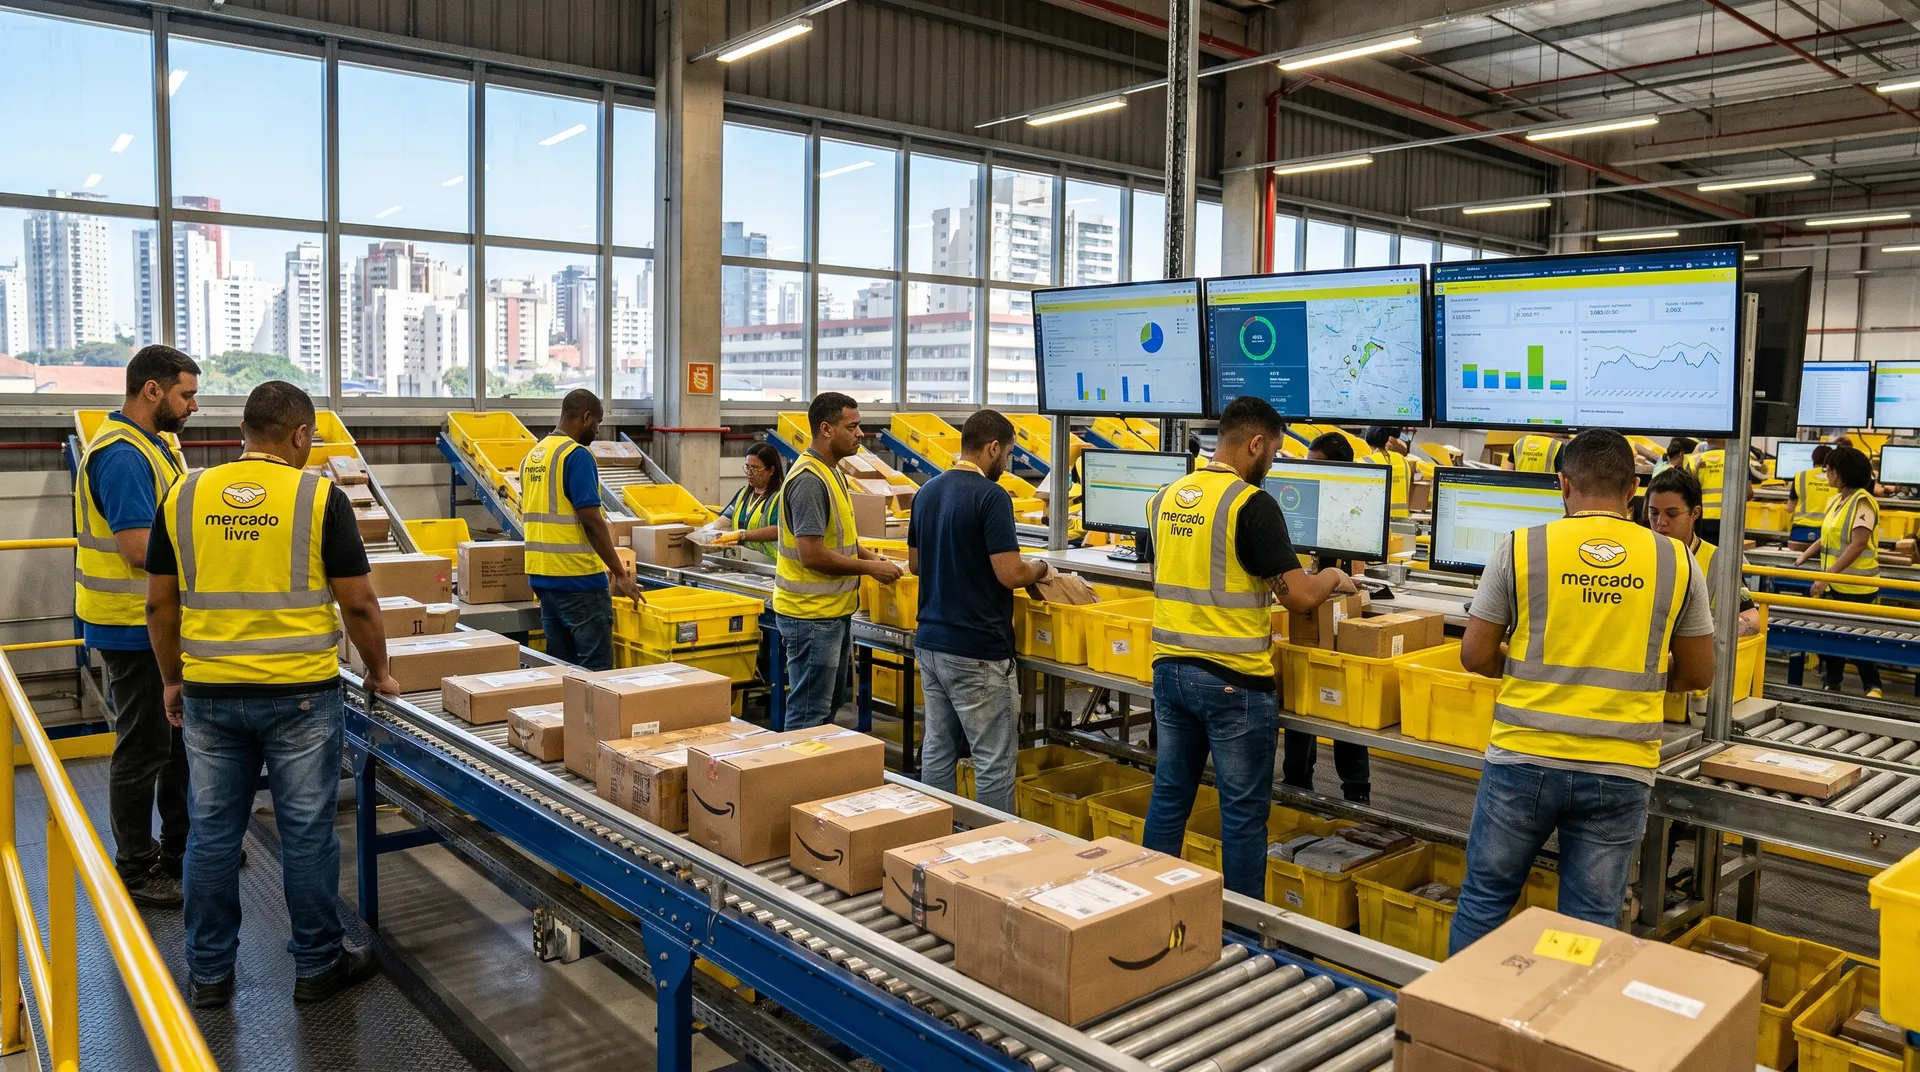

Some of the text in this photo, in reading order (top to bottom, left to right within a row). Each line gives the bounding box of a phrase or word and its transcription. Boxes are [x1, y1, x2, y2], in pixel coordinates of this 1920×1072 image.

[205, 513, 279, 527] mercado
[1161, 511, 1205, 525] mercado
[224, 526, 260, 541] livre
[1170, 523, 1193, 537] livre
[1561, 573, 1644, 589] mercado
[1582, 588, 1622, 604] livre
